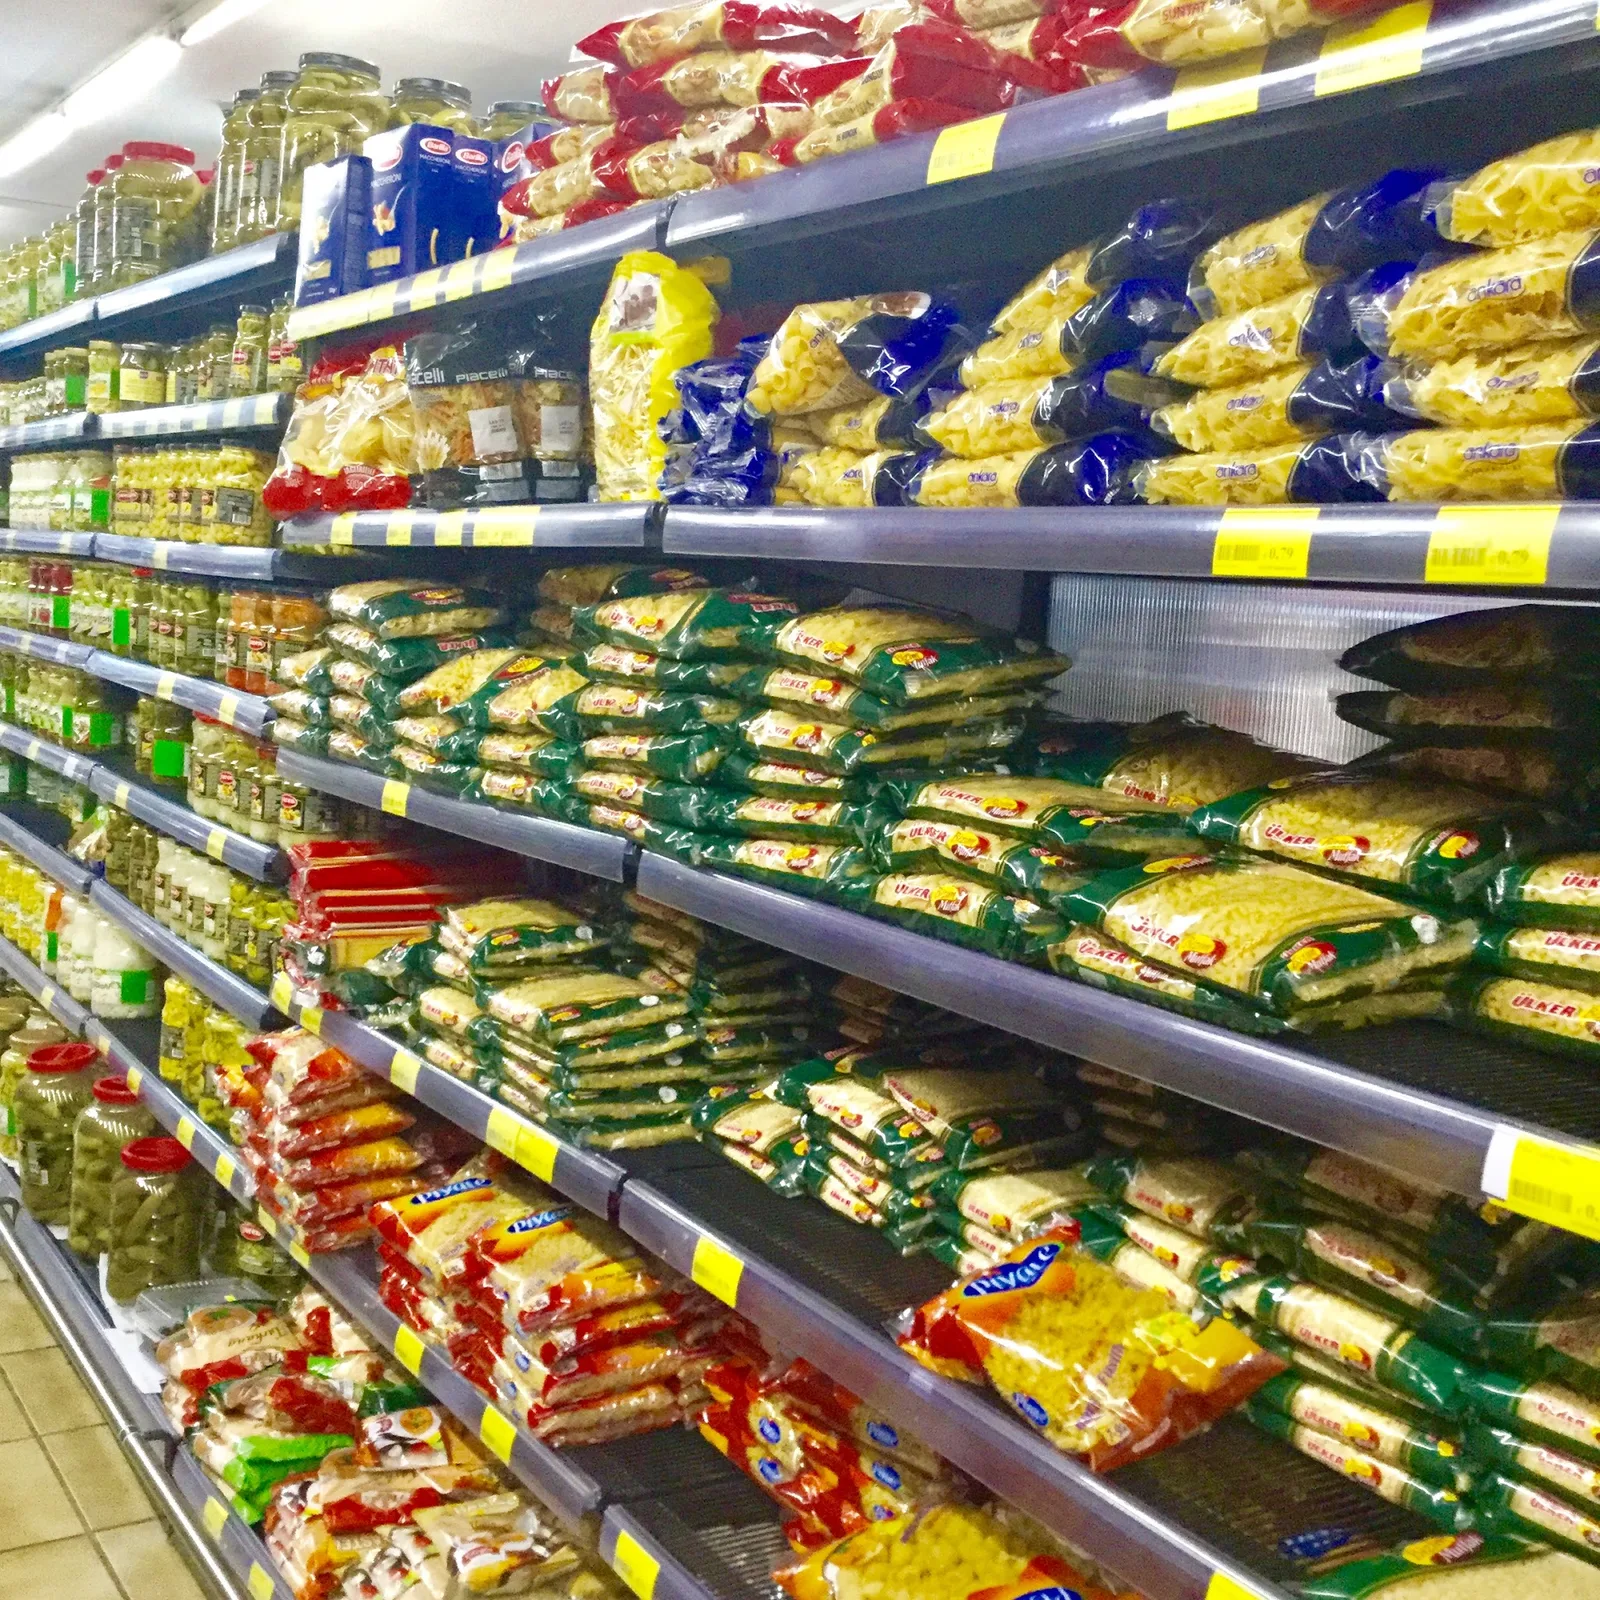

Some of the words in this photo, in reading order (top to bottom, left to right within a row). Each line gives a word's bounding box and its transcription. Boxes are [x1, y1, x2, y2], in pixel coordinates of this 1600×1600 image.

[462, 152, 487, 164] Barilla
[1467, 274, 1522, 300] ankara
[1463, 439, 1518, 461] ankara
[968, 468, 998, 483] ankara
[1215, 460, 1258, 478] ankara
[940, 787, 984, 805] ÜLKER
[909, 825, 948, 843] ÜLKER
[1265, 823, 1317, 847] ÜLKER
[895, 882, 931, 899] ÜLKER
[1078, 938, 1128, 964] ÜLKER
[1511, 993, 1578, 1019] ÜLKER
[970, 1245, 1055, 1296] Piyale
